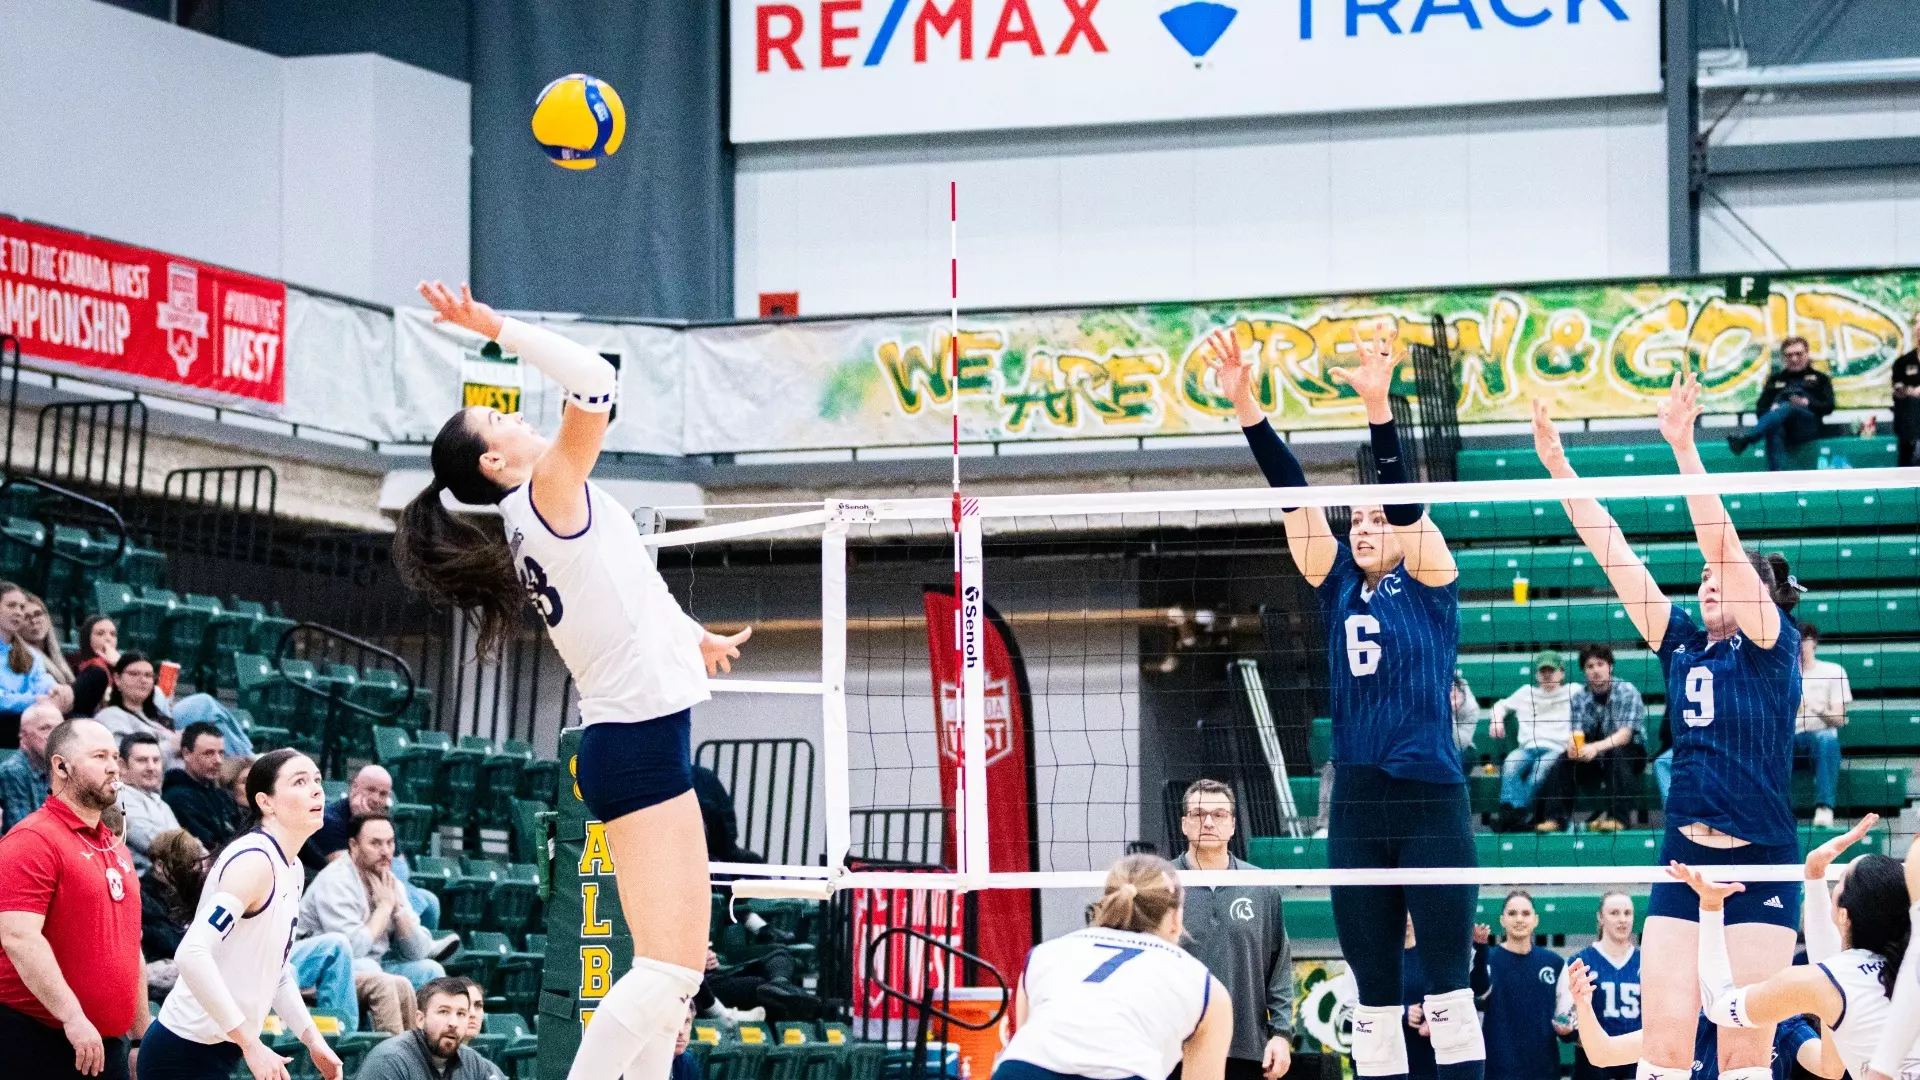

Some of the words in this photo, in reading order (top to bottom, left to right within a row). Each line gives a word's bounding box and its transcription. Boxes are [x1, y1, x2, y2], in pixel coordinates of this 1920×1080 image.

[756, 0, 1109, 73] RE/MAX
[10, 237, 29, 276] TO
[31, 242, 58, 282] THE
[59, 249, 112, 294] CANADA
[112, 262, 151, 300] WEST
[1741, 277, 1756, 298] F
[223, 325, 279, 385] WEST
[878, 328, 1003, 415] WE
[1000, 352, 1165, 433] ARE
[1531, 312, 1597, 382] &
[465, 384, 520, 414] WEST
[965, 605, 978, 669] Senoh
[1344, 614, 1382, 678] 6
[1682, 665, 1715, 728] 9
[1083, 943, 1146, 983] 7
[1600, 981, 1640, 1019] 15
